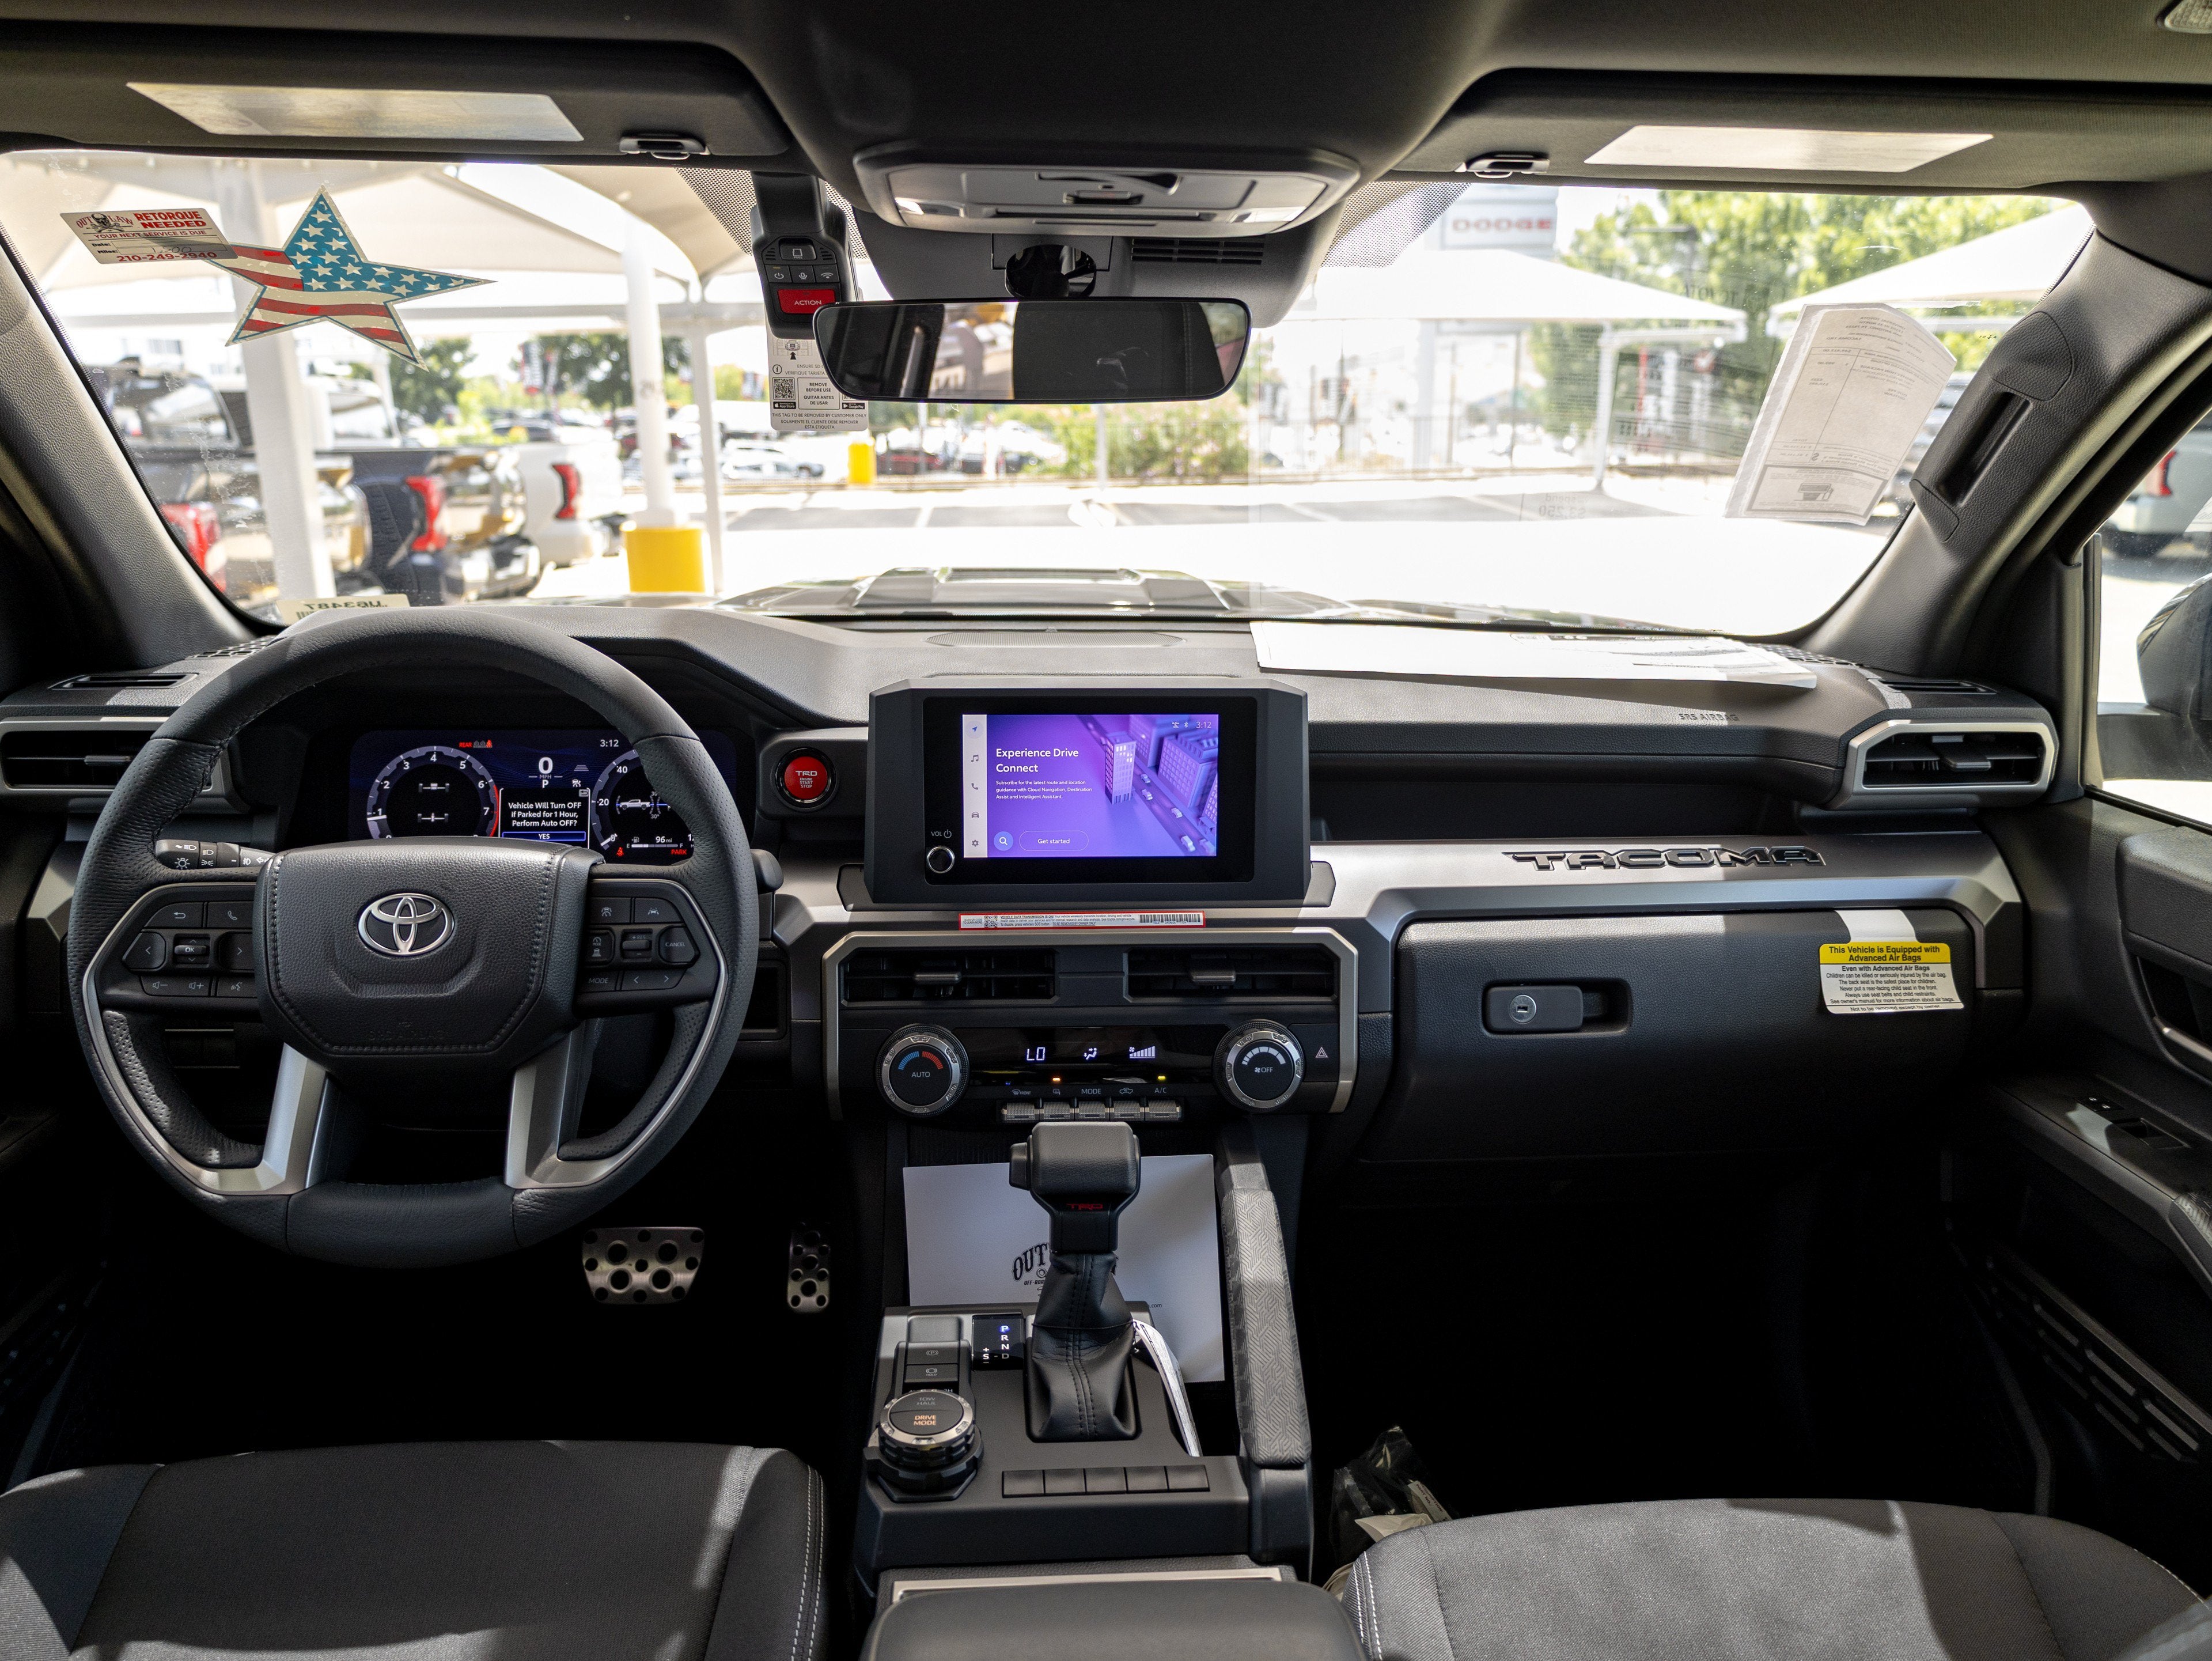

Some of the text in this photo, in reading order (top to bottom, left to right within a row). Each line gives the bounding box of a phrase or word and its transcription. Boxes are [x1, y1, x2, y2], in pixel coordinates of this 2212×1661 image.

[133, 211, 202, 221] RETORQUE
[141, 221, 206, 229] NEEDED
[1453, 218, 1552, 230] DODGE
[116, 251, 217, 262] 210-249-2940
[996, 748, 1078, 759] Experience Drive
[539, 757, 553, 774] 0
[996, 763, 1038, 773] Connect
[1501, 846, 1827, 871] TACOMA
[1886, 946, 1922, 954] Equipped
[1924, 946, 1940, 954] with
